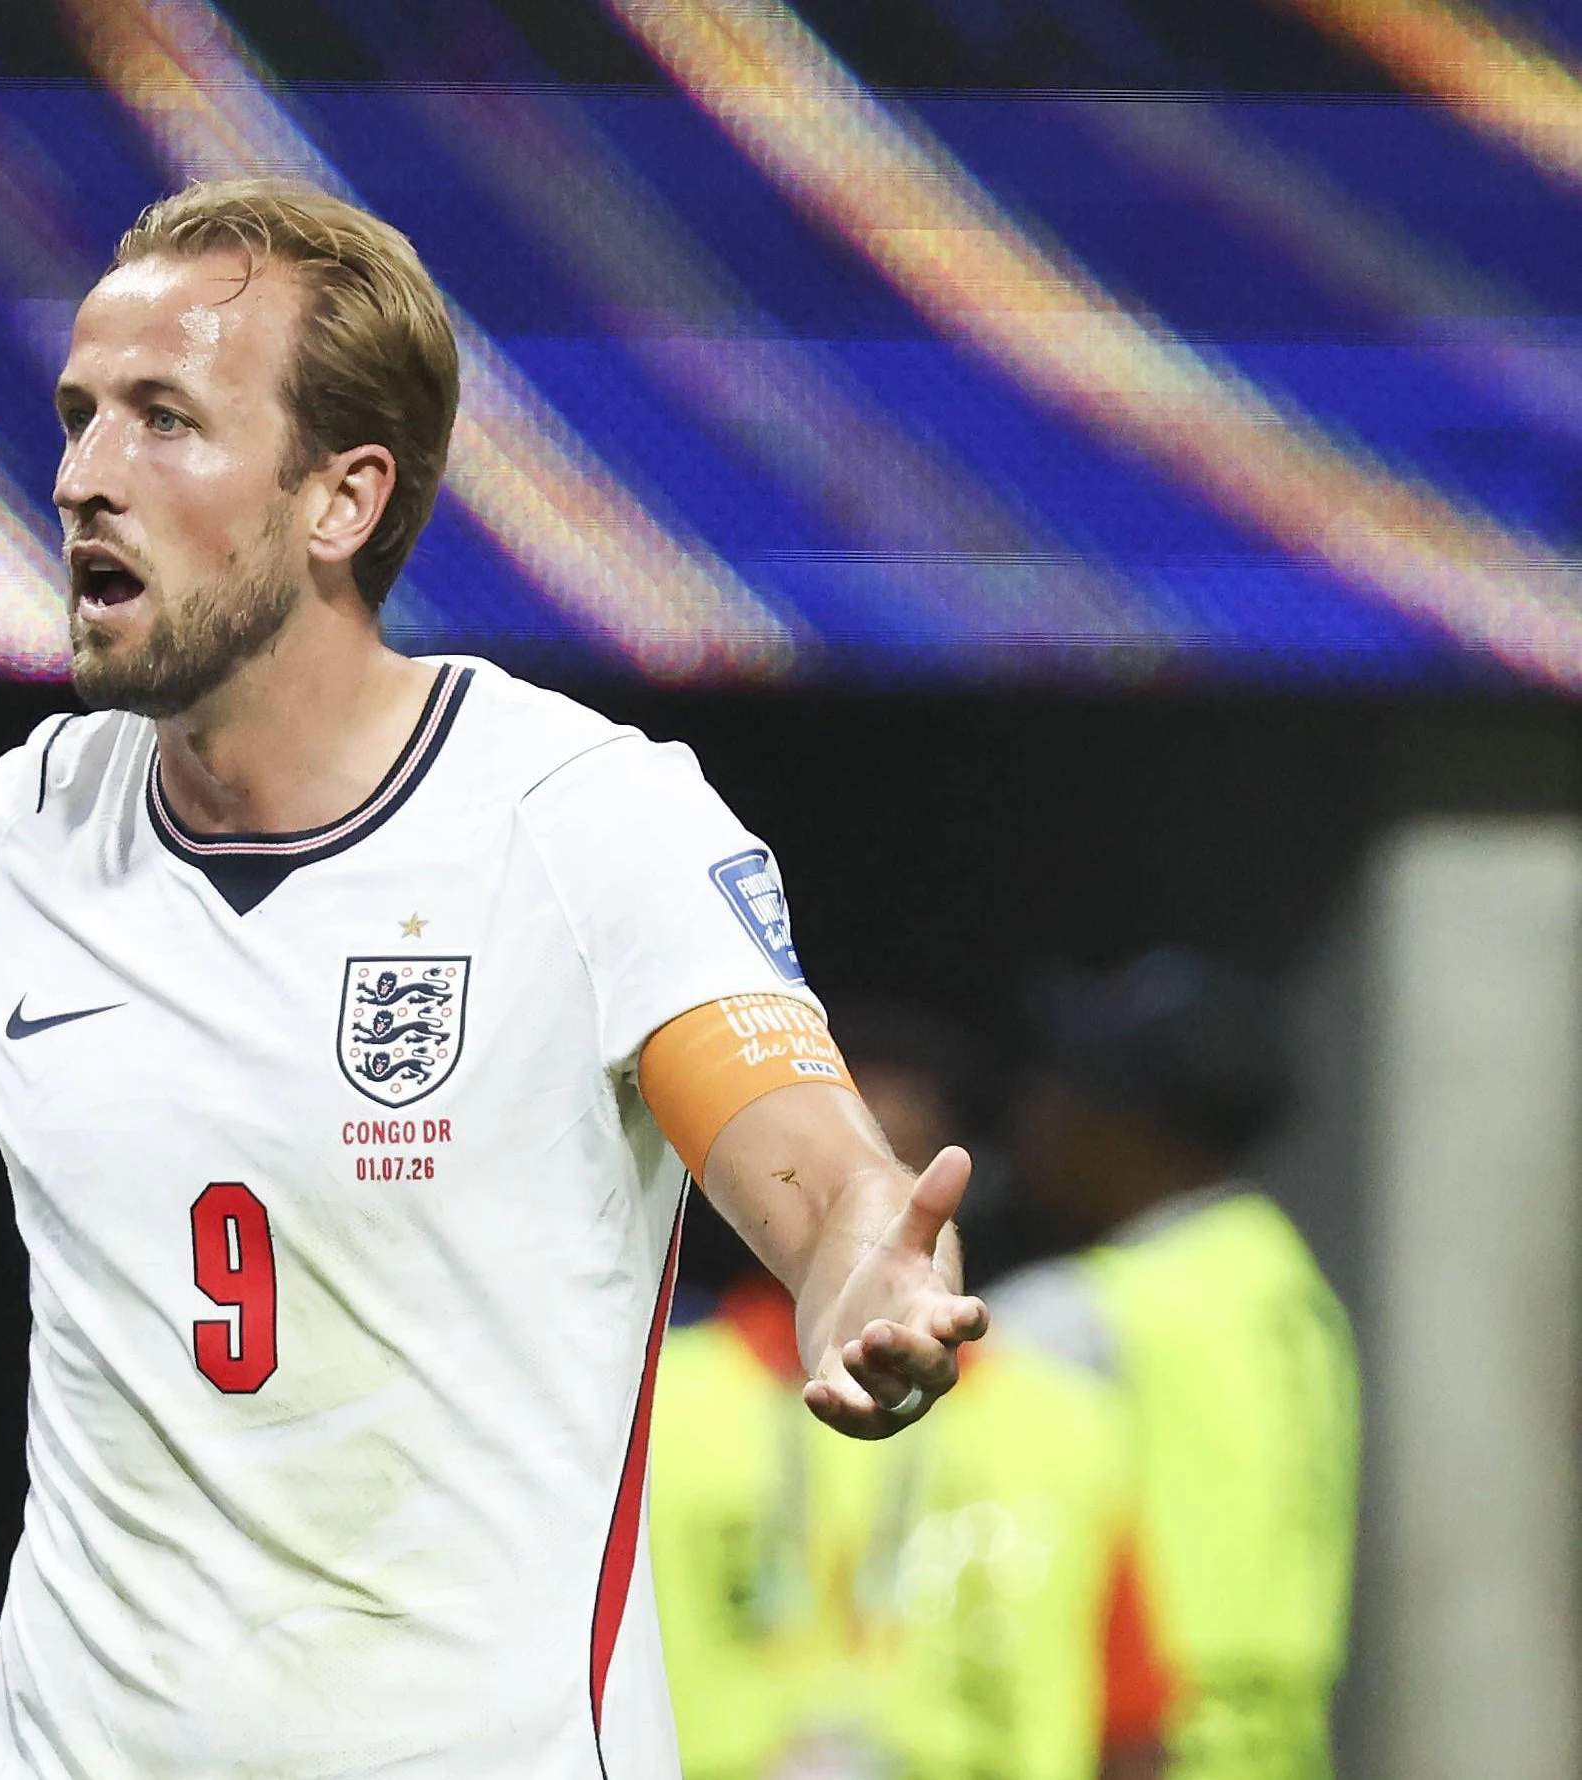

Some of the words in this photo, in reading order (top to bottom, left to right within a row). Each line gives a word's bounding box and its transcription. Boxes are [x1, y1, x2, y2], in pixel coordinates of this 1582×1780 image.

[726, 1004, 829, 1038] UNITE
[736, 1038, 788, 1067] the
[785, 1032, 844, 1066] Worl
[796, 1061, 837, 1075] FIFA
[342, 1119, 416, 1145] CONGO
[423, 1118, 452, 1143] DR
[356, 1156, 435, 1181] 01.07.26
[190, 1181, 278, 1395] 9
